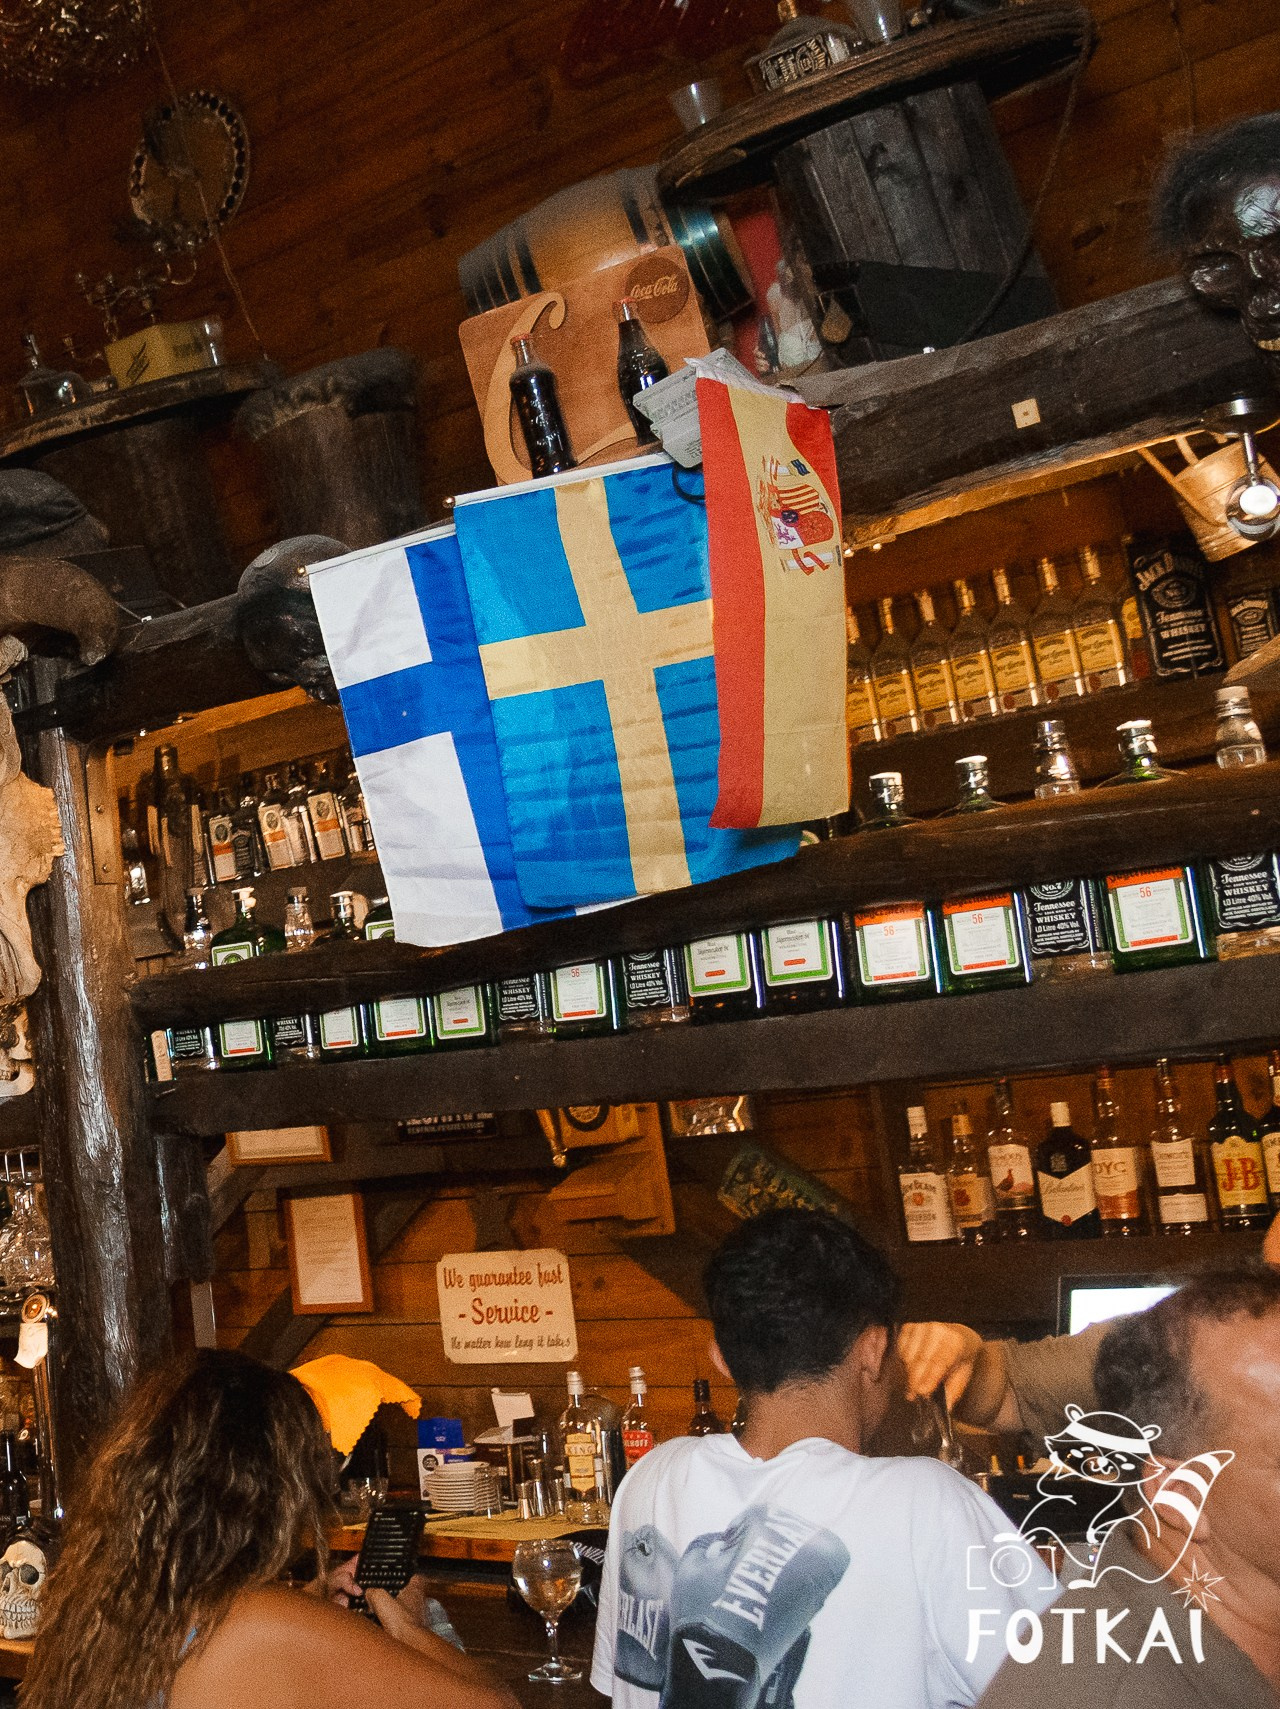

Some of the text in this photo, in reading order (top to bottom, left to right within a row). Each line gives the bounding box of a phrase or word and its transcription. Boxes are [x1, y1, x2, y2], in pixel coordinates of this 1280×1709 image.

[1220, 871, 1268, 884] Tennessee
[1041, 882, 1062, 893] No.7
[1139, 886, 1152, 898] 56
[1223, 883, 1270, 897] WHISKEY
[1033, 900, 1076, 912] Tennessee
[972, 913, 983, 925] 56
[1036, 912, 1076, 924] WHISKEY
[883, 925, 895, 937] 56
[629, 961, 660, 971] Tennessee
[571, 968, 580, 978] 56
[630, 972, 662, 982] WHISKEY
[502, 987, 531, 995] WHISKEY
[443, 1262, 563, 1292] We guarantee fast
[471, 1297, 541, 1325] Service
[464, 1337, 492, 1350] matter
[515, 1335, 534, 1351] long
[537, 1335, 545, 1348] it
[546, 1334, 571, 1348] takes
